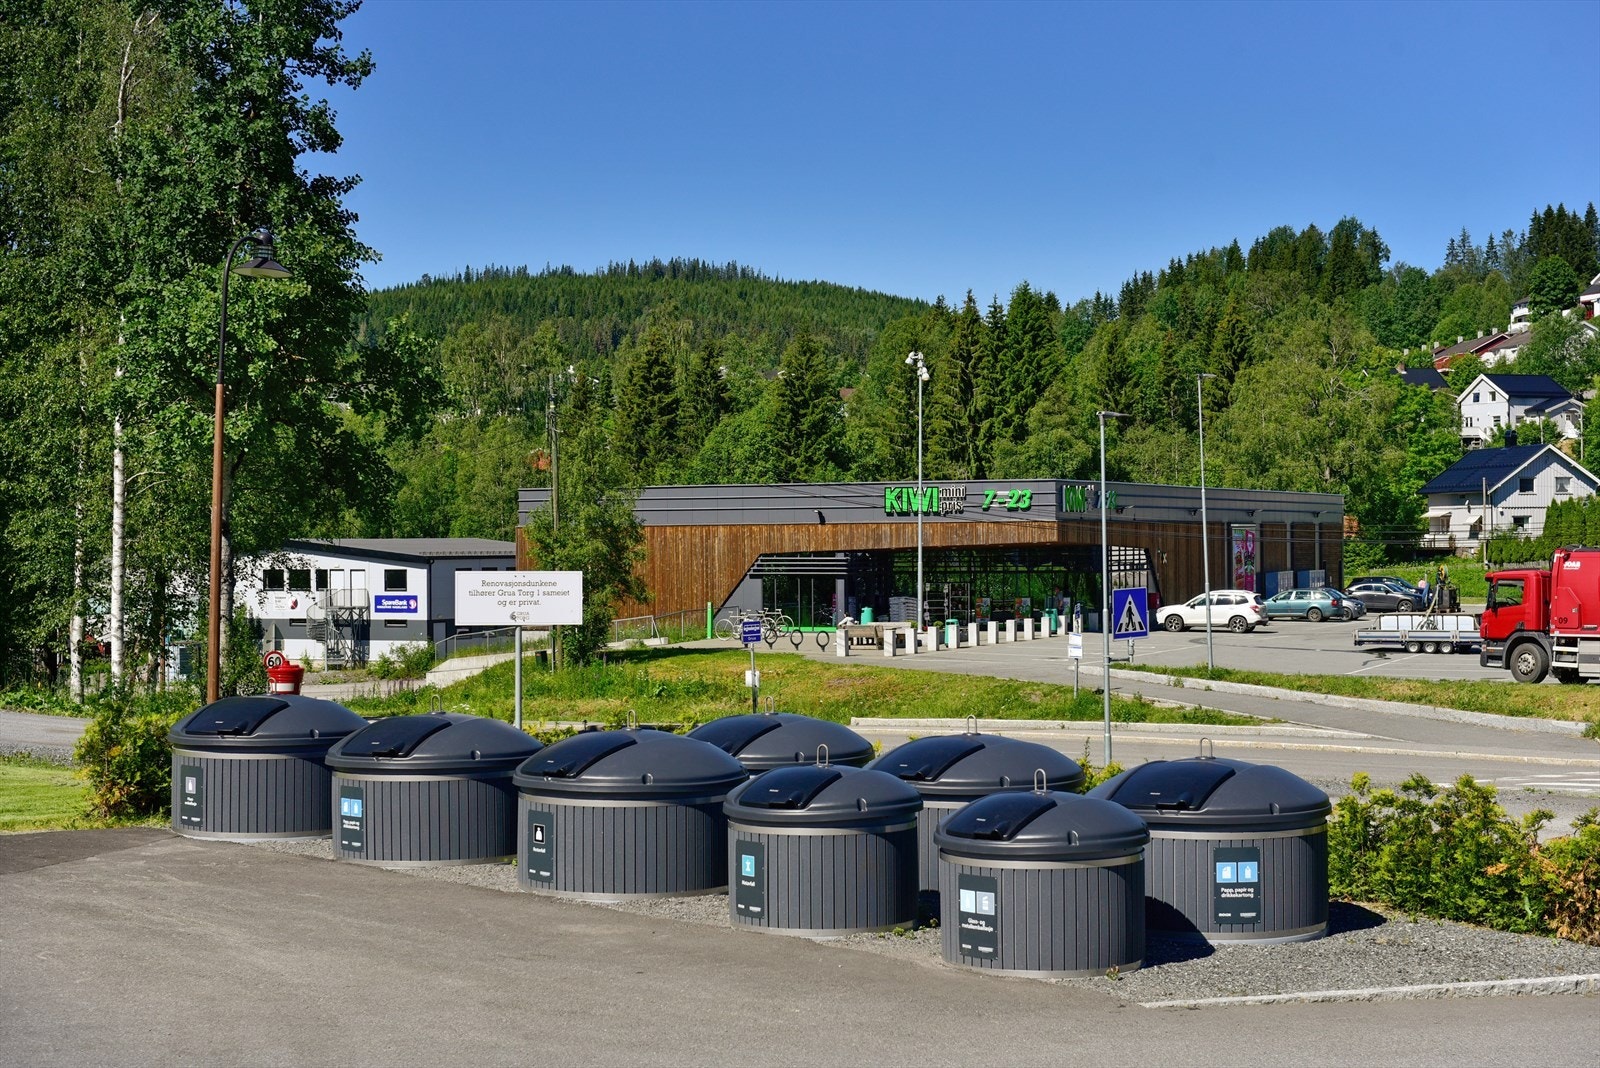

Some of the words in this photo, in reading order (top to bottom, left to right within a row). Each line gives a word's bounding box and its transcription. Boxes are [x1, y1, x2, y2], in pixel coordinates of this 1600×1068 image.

[940, 484, 966, 497] mini
[884, 486, 939, 515] KIWI
[940, 499, 963, 516] pris
[481, 580, 557, 588] Renovasjonsdunkene
[518, 589, 534, 598] Torg
[518, 599, 541, 607] privat.
[267, 656, 282, 667] 60
